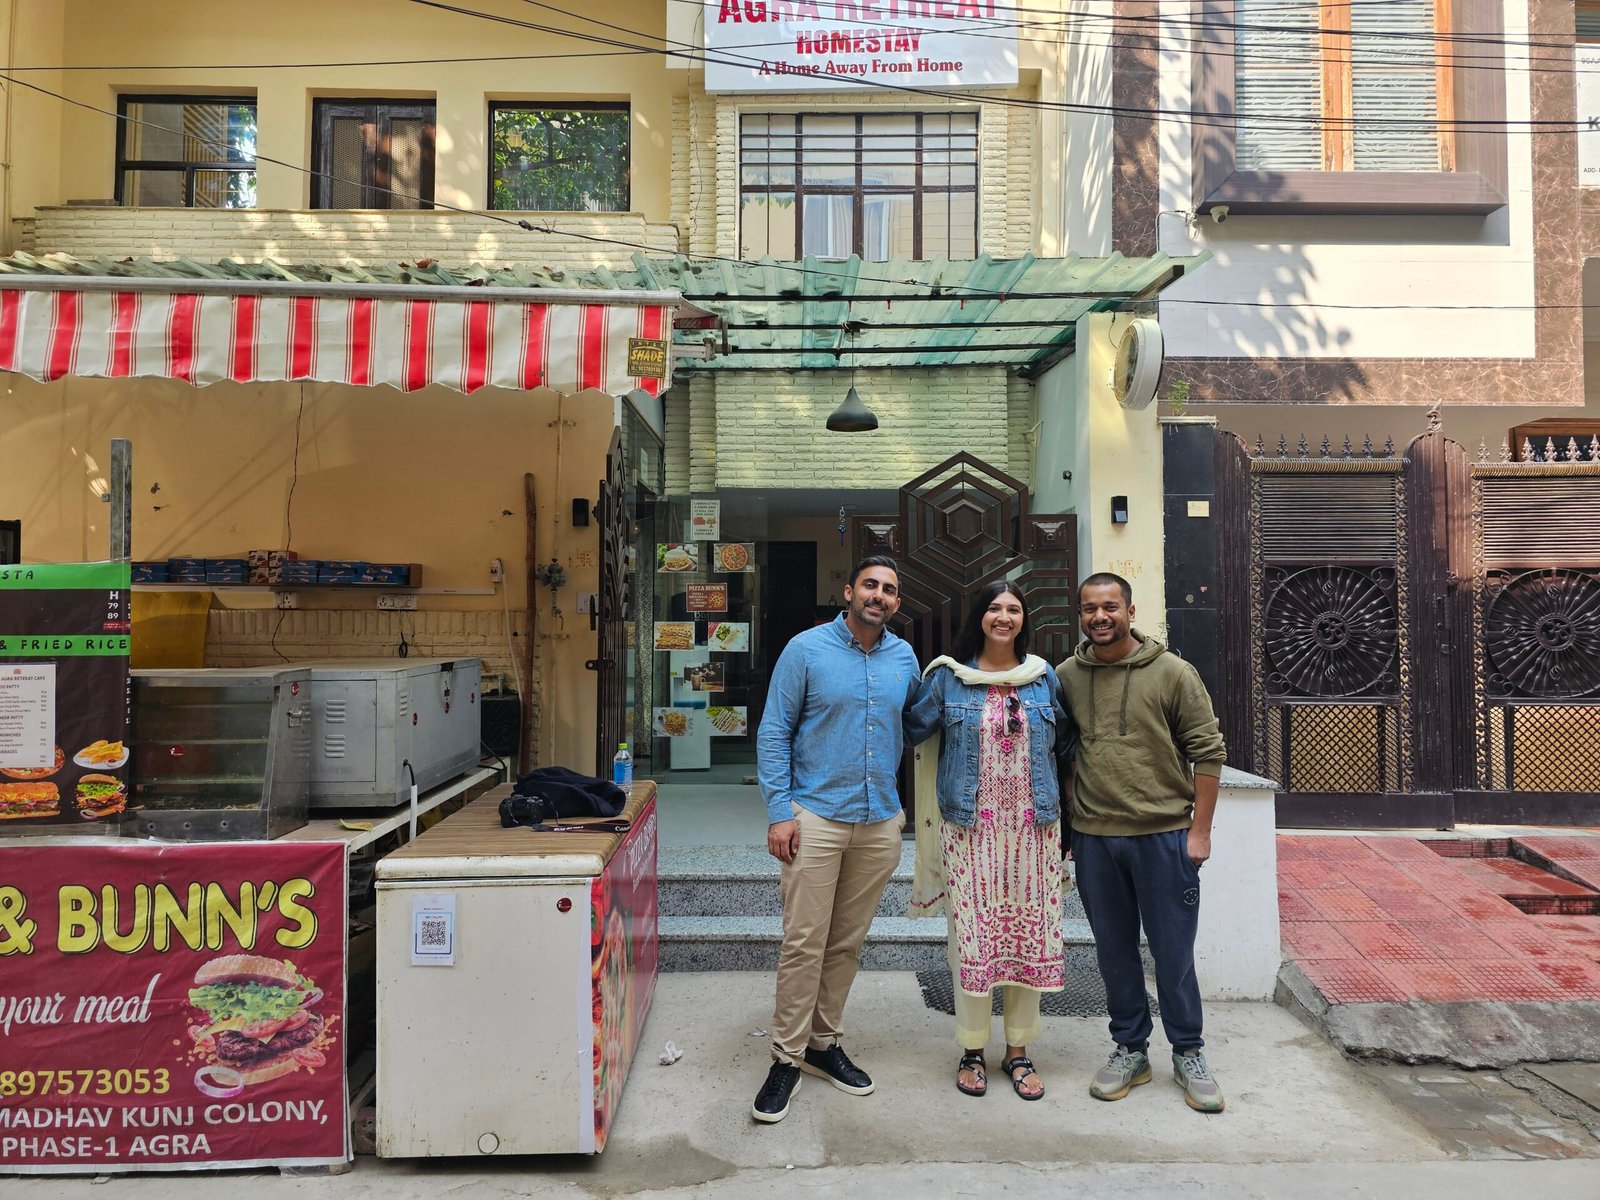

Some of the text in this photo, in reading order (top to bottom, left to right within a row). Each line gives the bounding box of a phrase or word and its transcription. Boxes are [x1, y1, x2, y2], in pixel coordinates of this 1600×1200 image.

[796, 28, 922, 54] HOMESTAY
[759, 58, 963, 77] A Home Away From Home
[631, 350, 664, 362] SHADE
[109, 591, 119, 600] H
[107, 612, 119, 620] 89
[0, 639, 127, 650] & FRIED RICE
[0, 878, 320, 957] & BUNN'S
[0, 973, 161, 1036] your meal
[0, 1068, 170, 1096] 897573053
[122, 1106, 194, 1128] KUNJ
[204, 1099, 328, 1125] COLONY,
[2, 1133, 212, 1157] PHASE-1 AGRA
